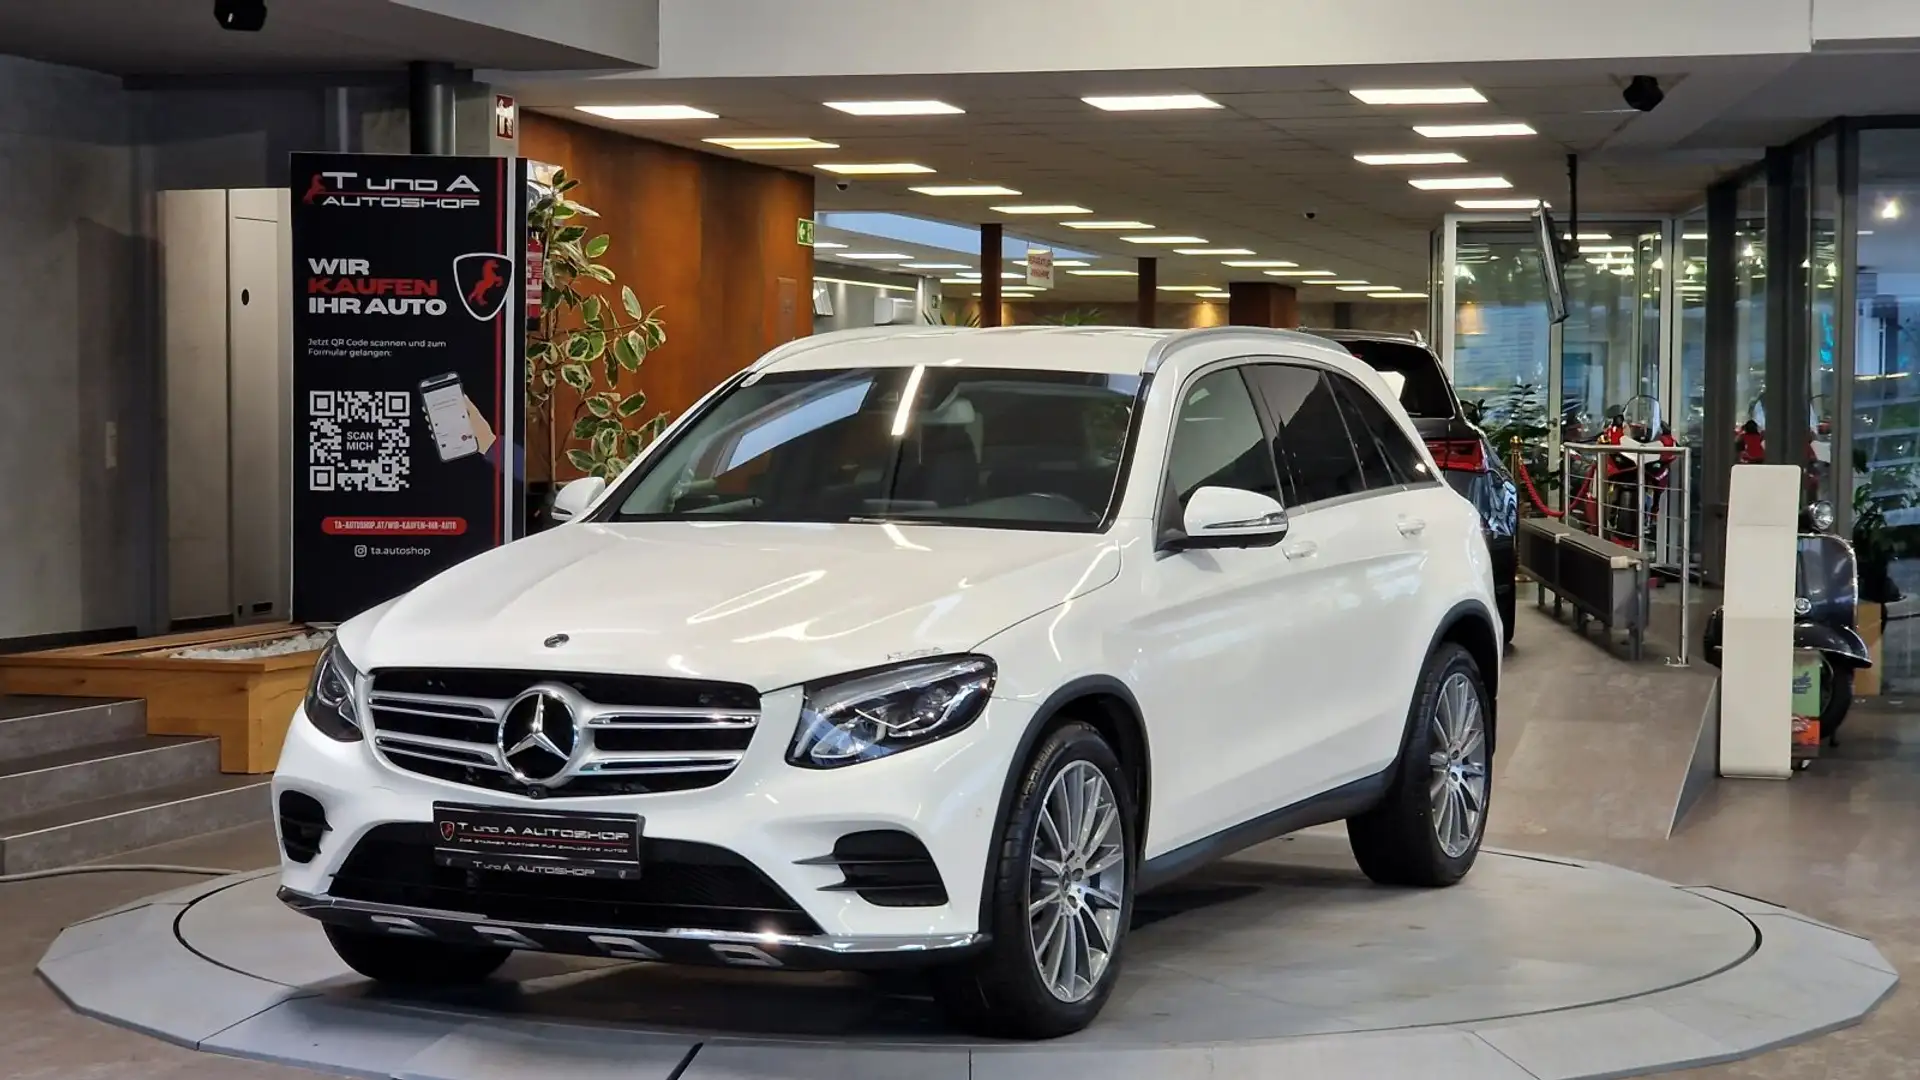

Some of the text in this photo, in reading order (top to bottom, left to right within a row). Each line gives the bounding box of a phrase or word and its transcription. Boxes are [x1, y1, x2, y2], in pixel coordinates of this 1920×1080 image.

[322, 172, 357, 189] T
[446, 175, 480, 192] A
[322, 196, 480, 208] AUTOSHOP
[308, 258, 369, 275] WIR
[308, 278, 438, 296] KAUFEN
[309, 297, 447, 316] IHR AUTO
[308, 338, 329, 346] Jetzt
[331, 338, 344, 347] QR
[408, 339, 425, 347] und
[308, 348, 347, 356] Formular
[346, 431, 373, 440] SCAN
[346, 441, 373, 451] MICH
[370, 546, 431, 557] ta.autoshop
[457, 822, 468, 831] T
[504, 826, 516, 835] A
[522, 826, 629, 841] AUTOSHOP
[473, 860, 483, 868] T
[502, 863, 512, 872] A
[517, 863, 595, 876] AUTOSHOP
